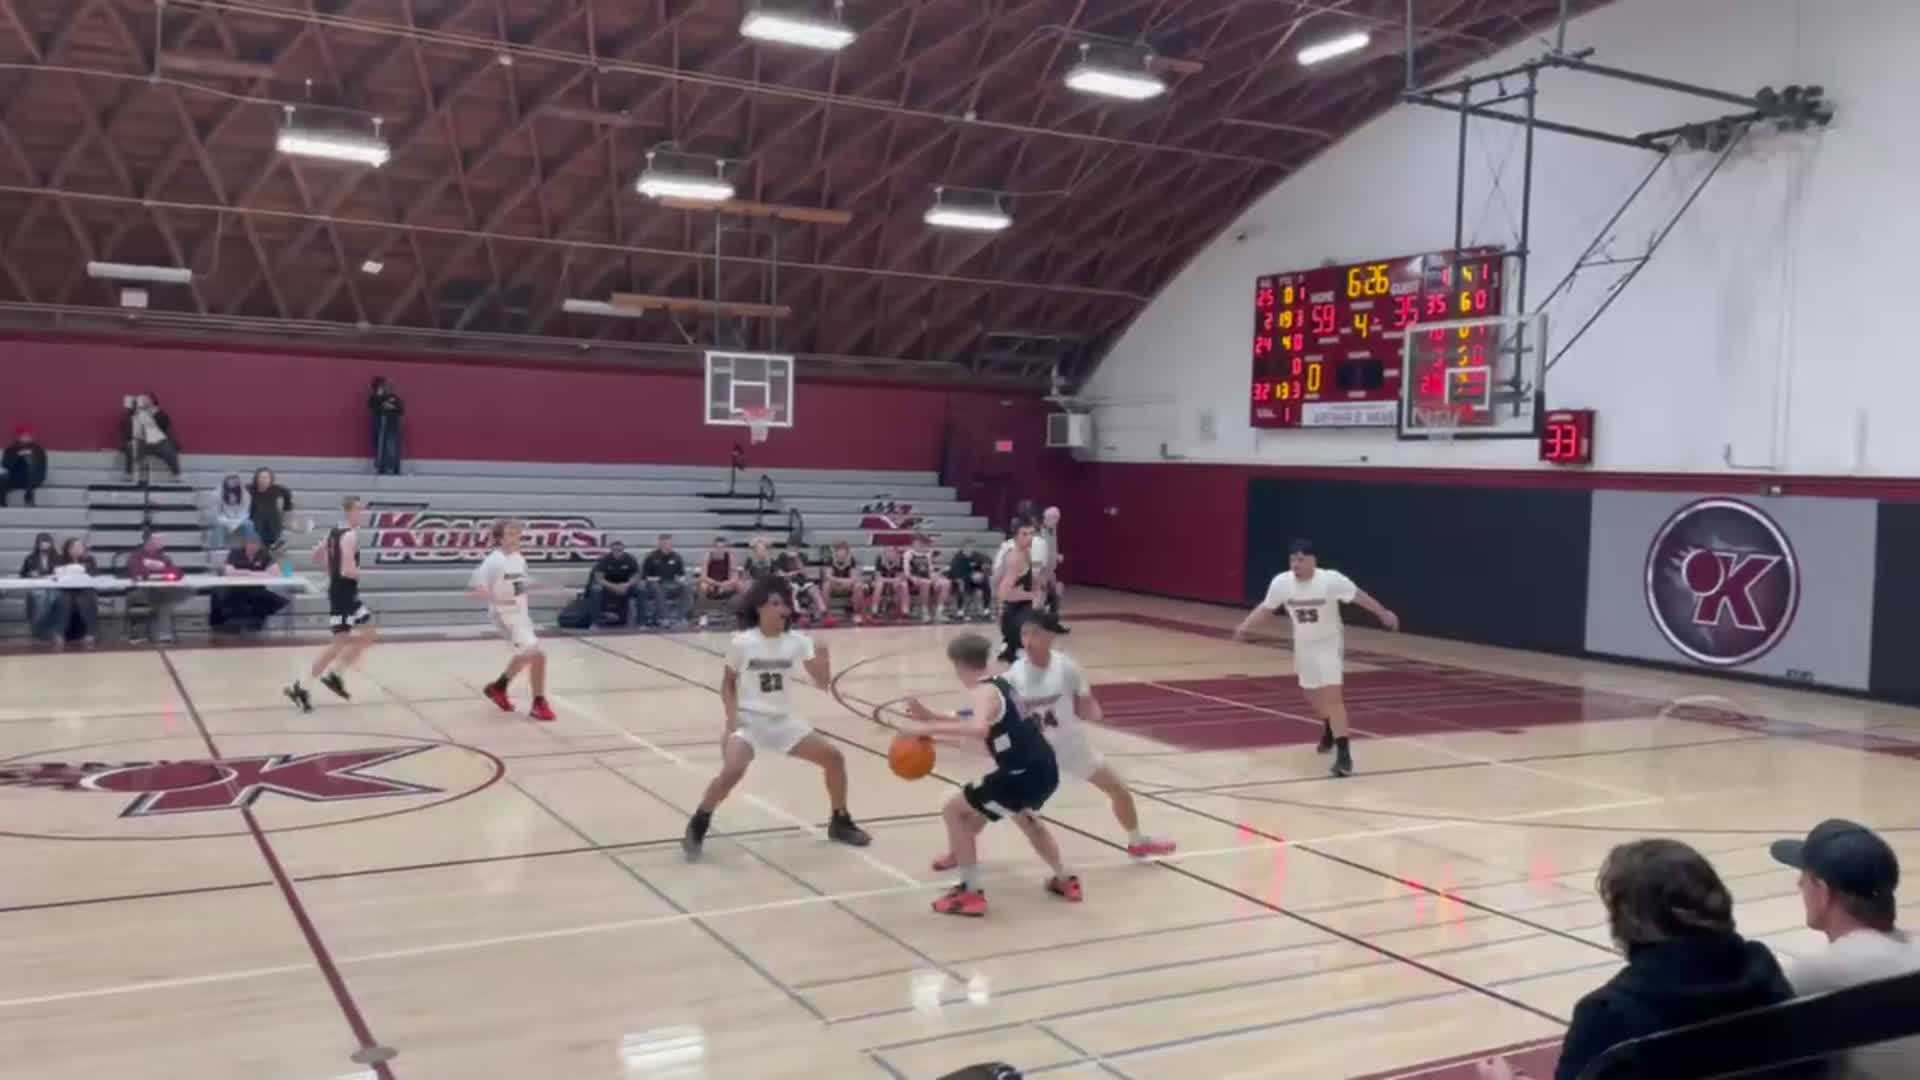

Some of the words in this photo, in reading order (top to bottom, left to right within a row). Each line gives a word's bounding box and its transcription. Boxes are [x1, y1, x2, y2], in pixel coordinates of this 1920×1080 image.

[1311, 303, 1336, 334] 59
[1353, 313, 1368, 339] 4
[1393, 295, 1419, 328] 35
[1307, 362, 1321, 392] 0
[1546, 424, 1576, 458] 33
